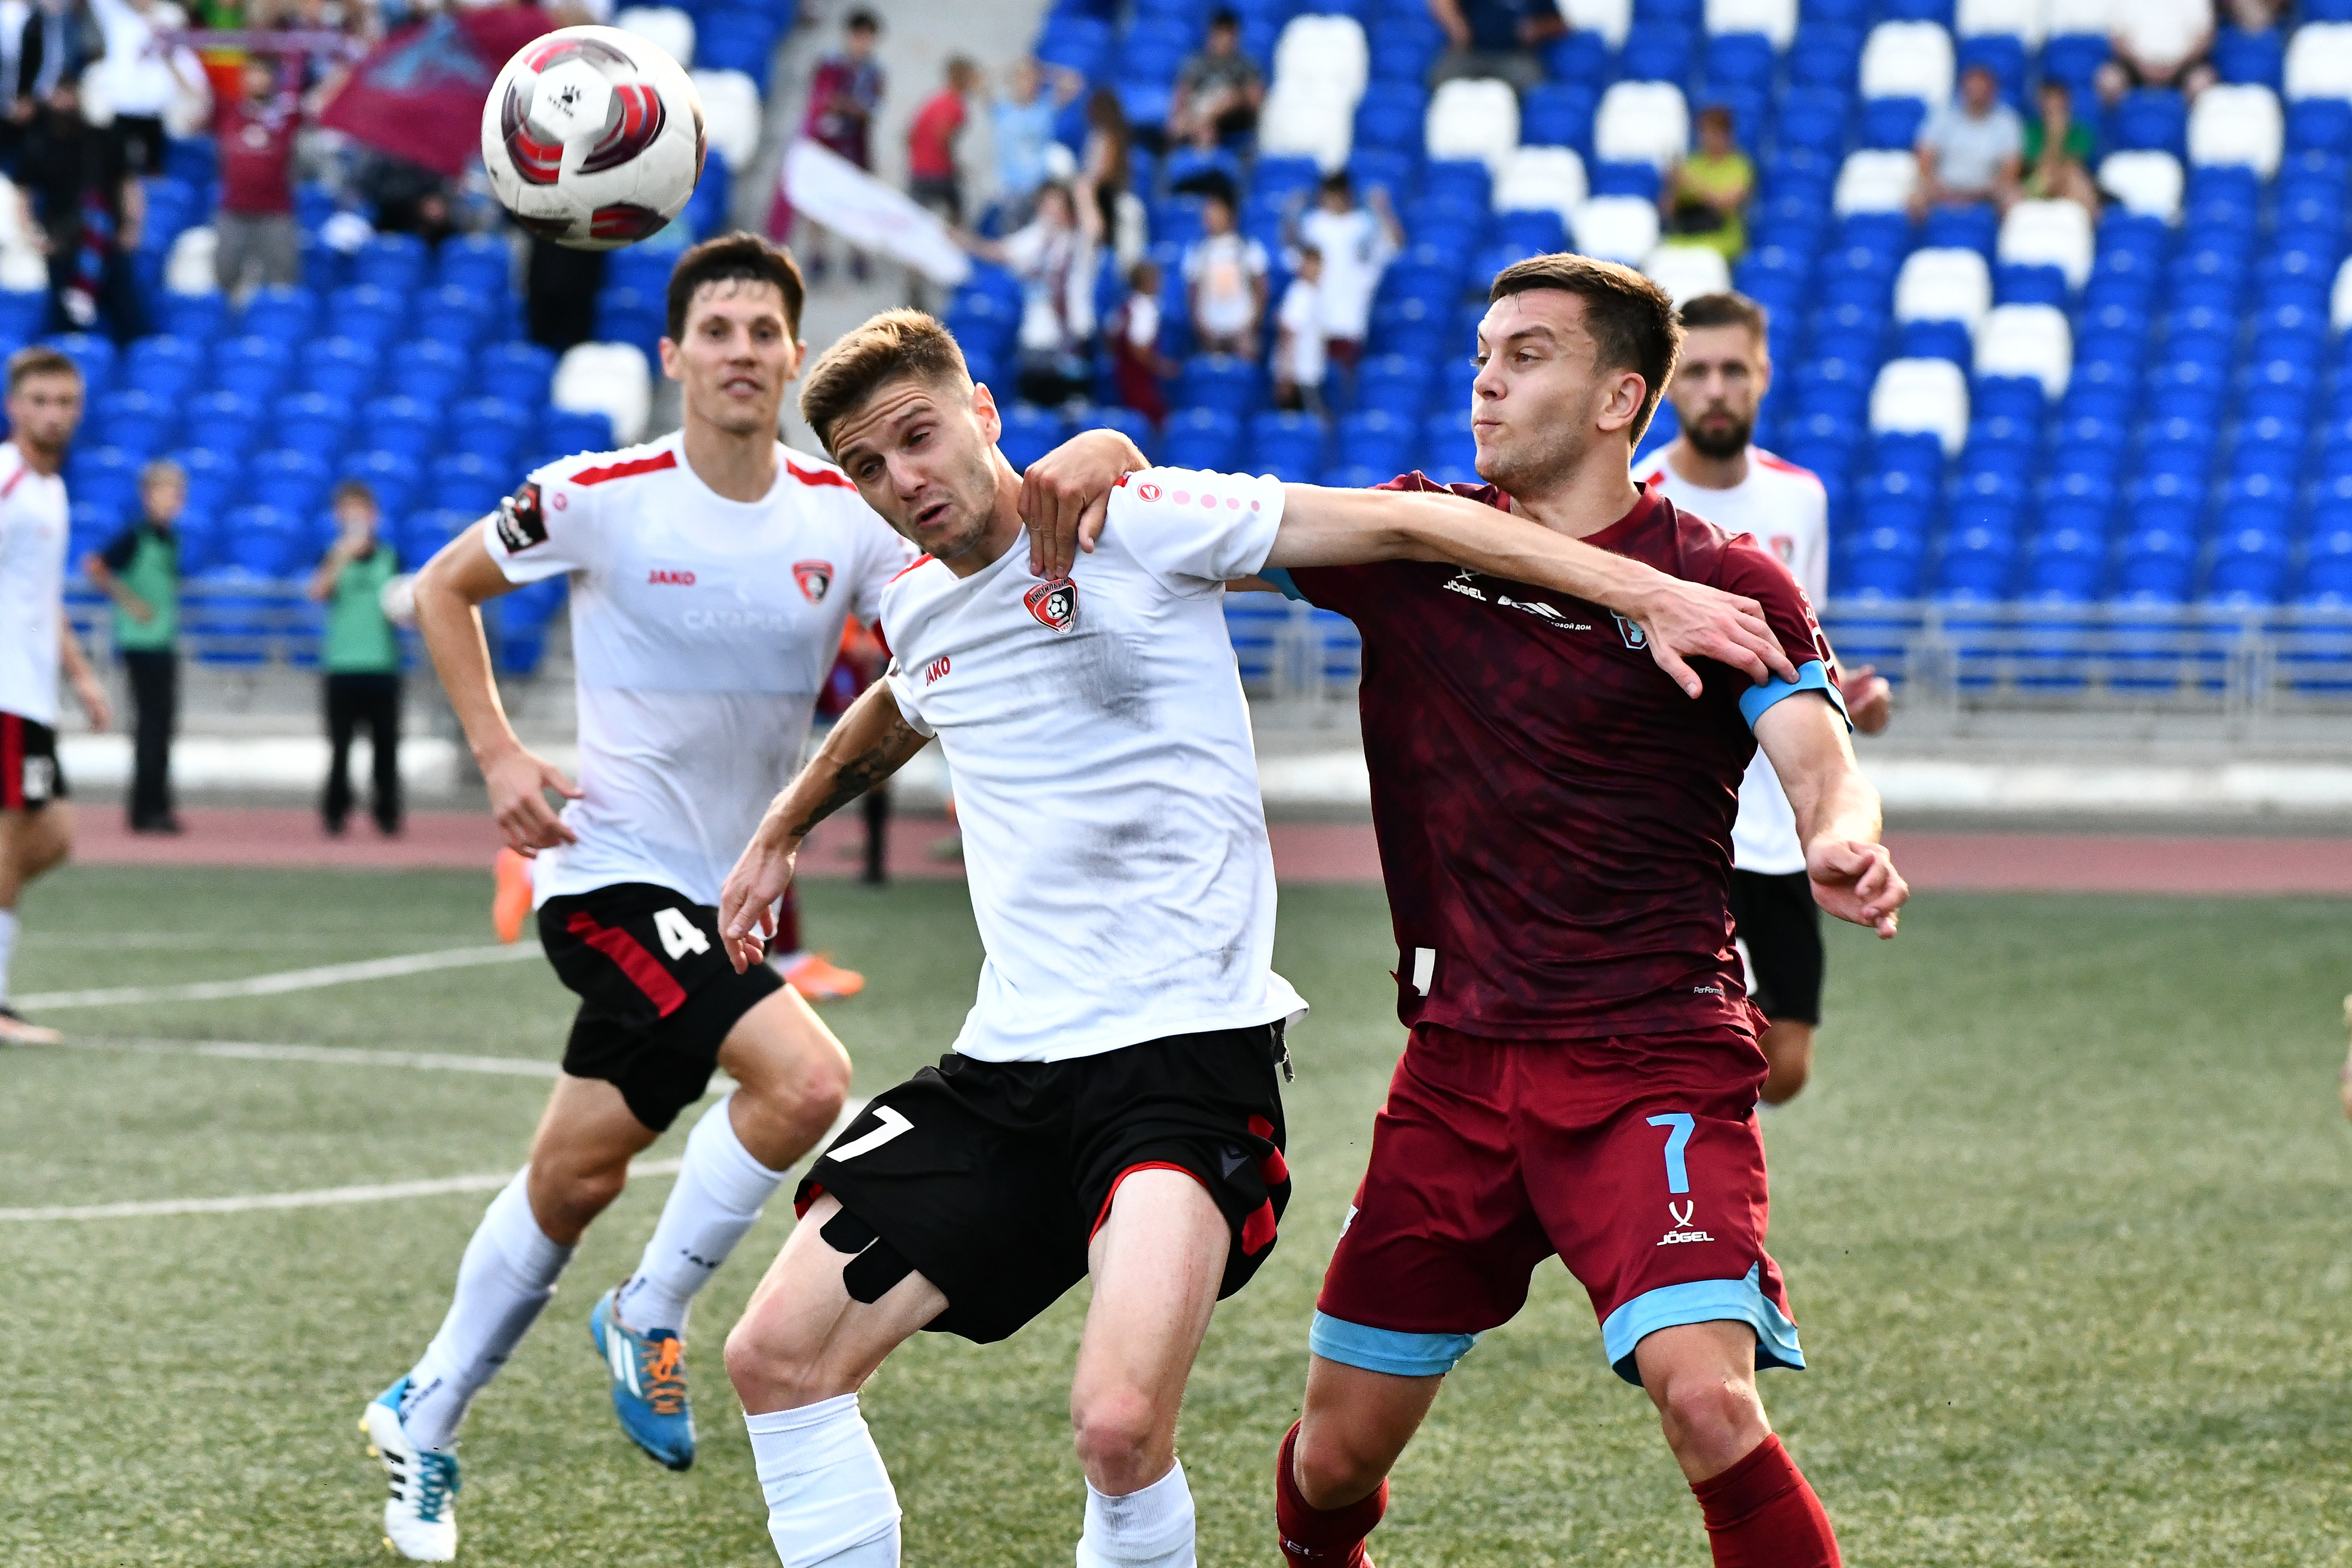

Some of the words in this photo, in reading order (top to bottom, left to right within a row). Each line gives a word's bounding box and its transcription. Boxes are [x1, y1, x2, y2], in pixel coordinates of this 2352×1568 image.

[648, 569, 696, 586] JAKO
[1443, 580, 1487, 601] JÖGEL
[925, 656, 950, 687] JAKO
[652, 907, 711, 960] 4
[825, 1105, 915, 1163] 7
[1646, 1113, 1696, 1194] 7
[1656, 1230, 1715, 1246] JÖGEL
